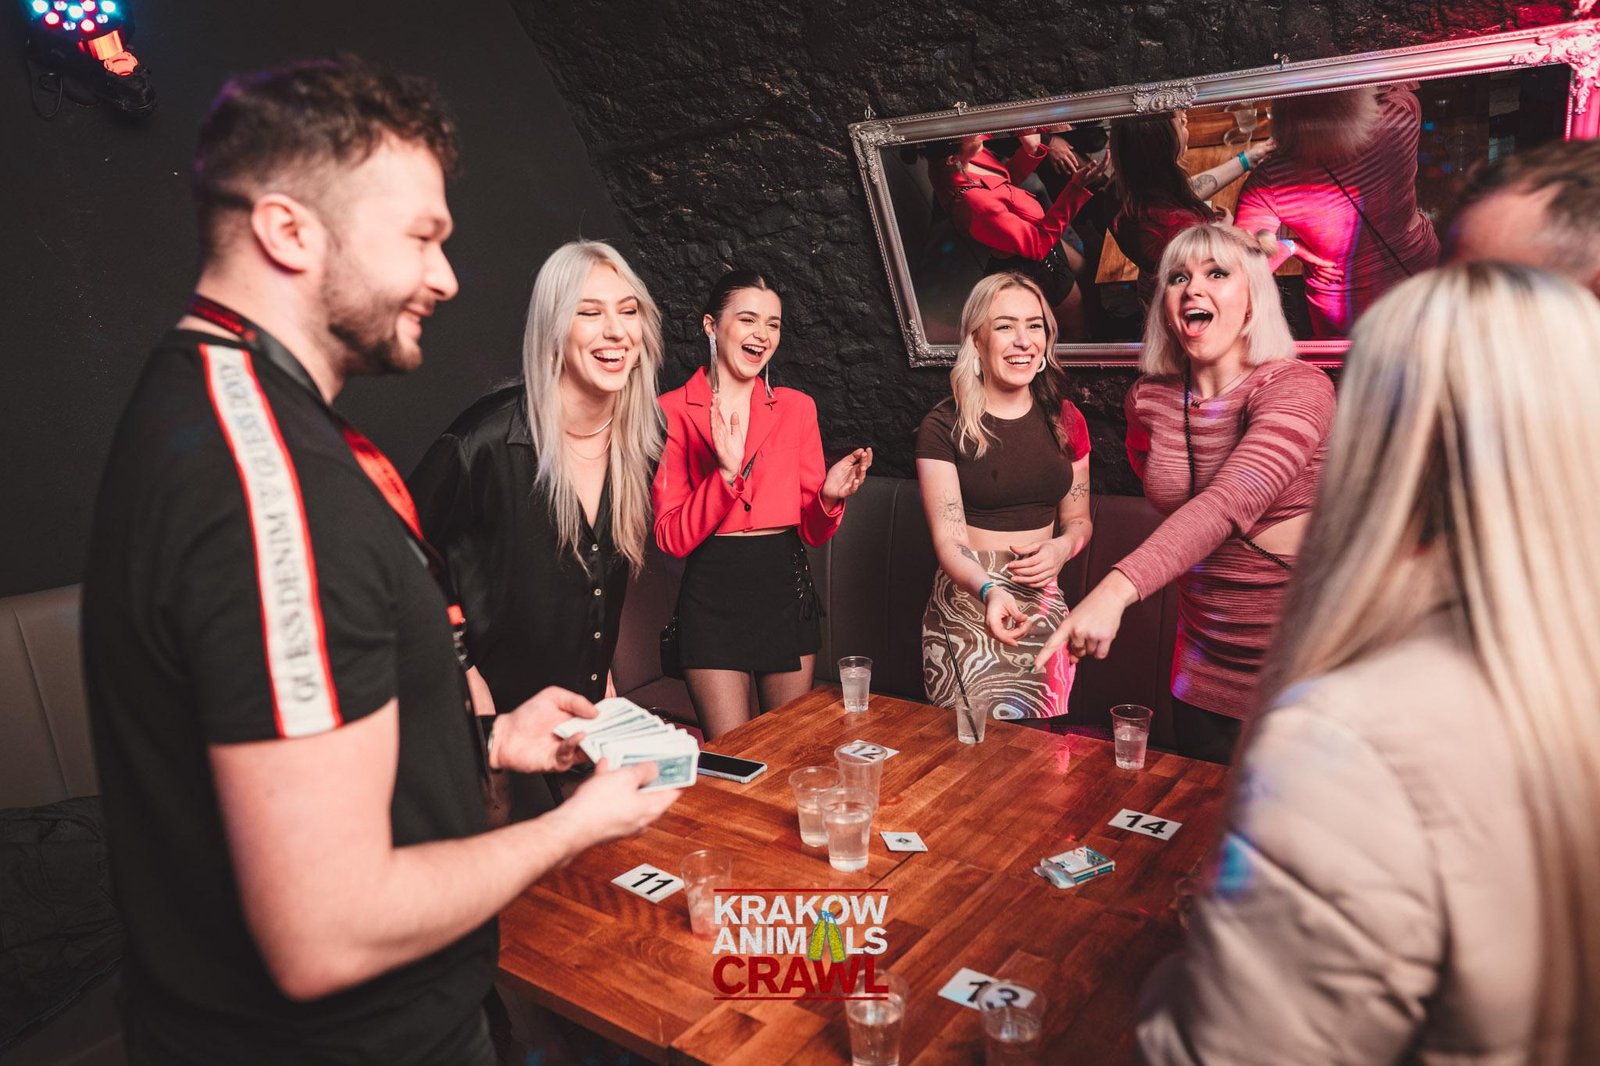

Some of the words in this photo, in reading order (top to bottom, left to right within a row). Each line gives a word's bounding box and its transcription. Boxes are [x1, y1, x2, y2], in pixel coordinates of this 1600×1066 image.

[1126, 814, 1168, 835] 14
[631, 872, 675, 895] 11
[966, 980, 1021, 1010] 13
